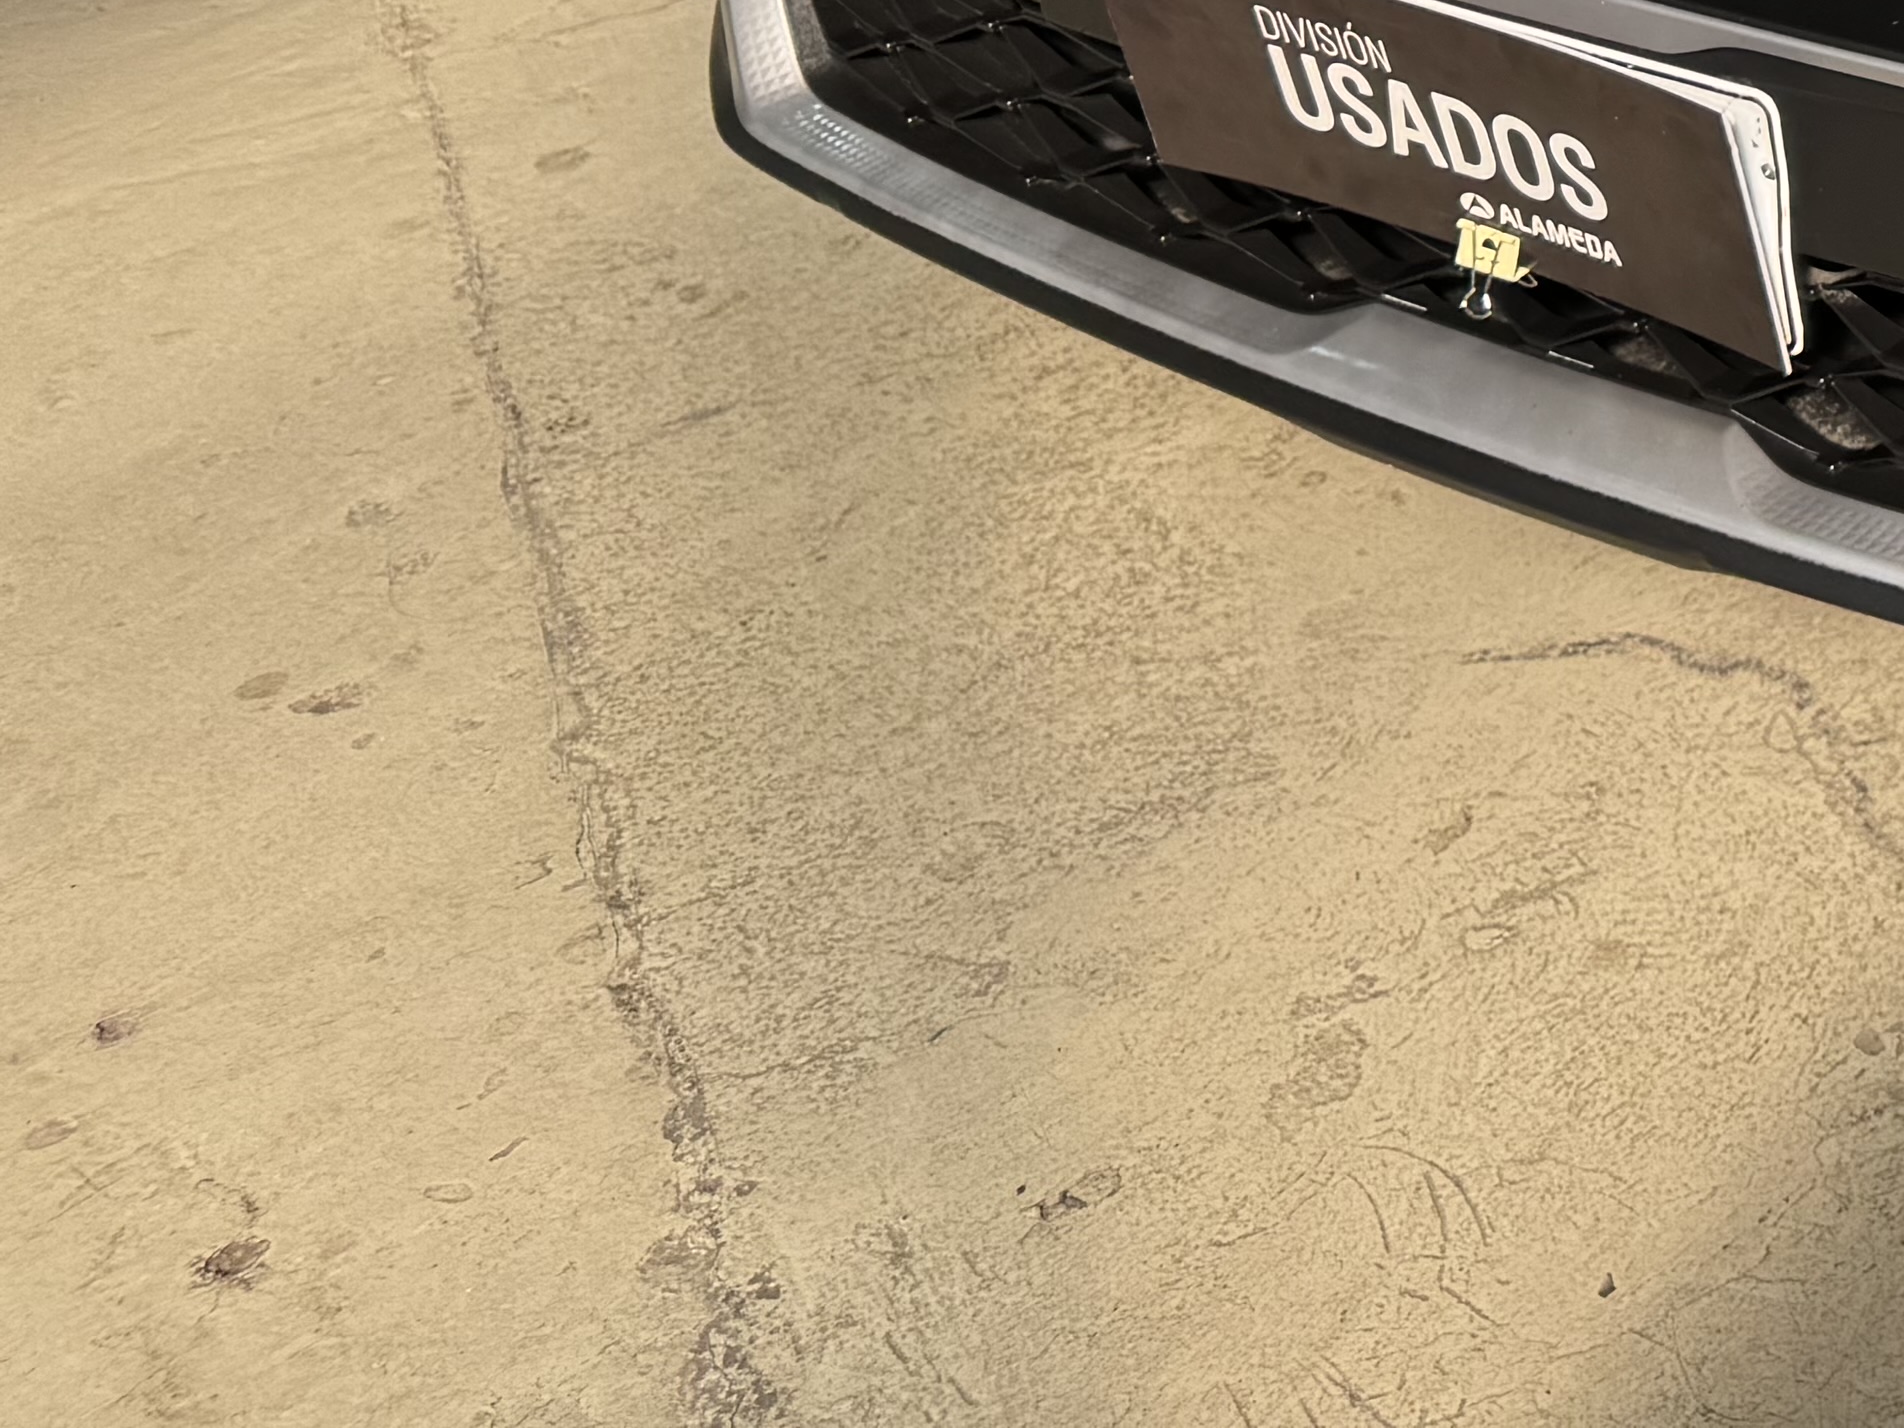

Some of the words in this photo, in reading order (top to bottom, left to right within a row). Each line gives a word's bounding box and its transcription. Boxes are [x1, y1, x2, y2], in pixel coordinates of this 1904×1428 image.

[1253, 4, 1392, 73] DIVISIÓN
[1267, 44, 1608, 221] USADOS
[1500, 203, 1622, 267] ALAMEDA
